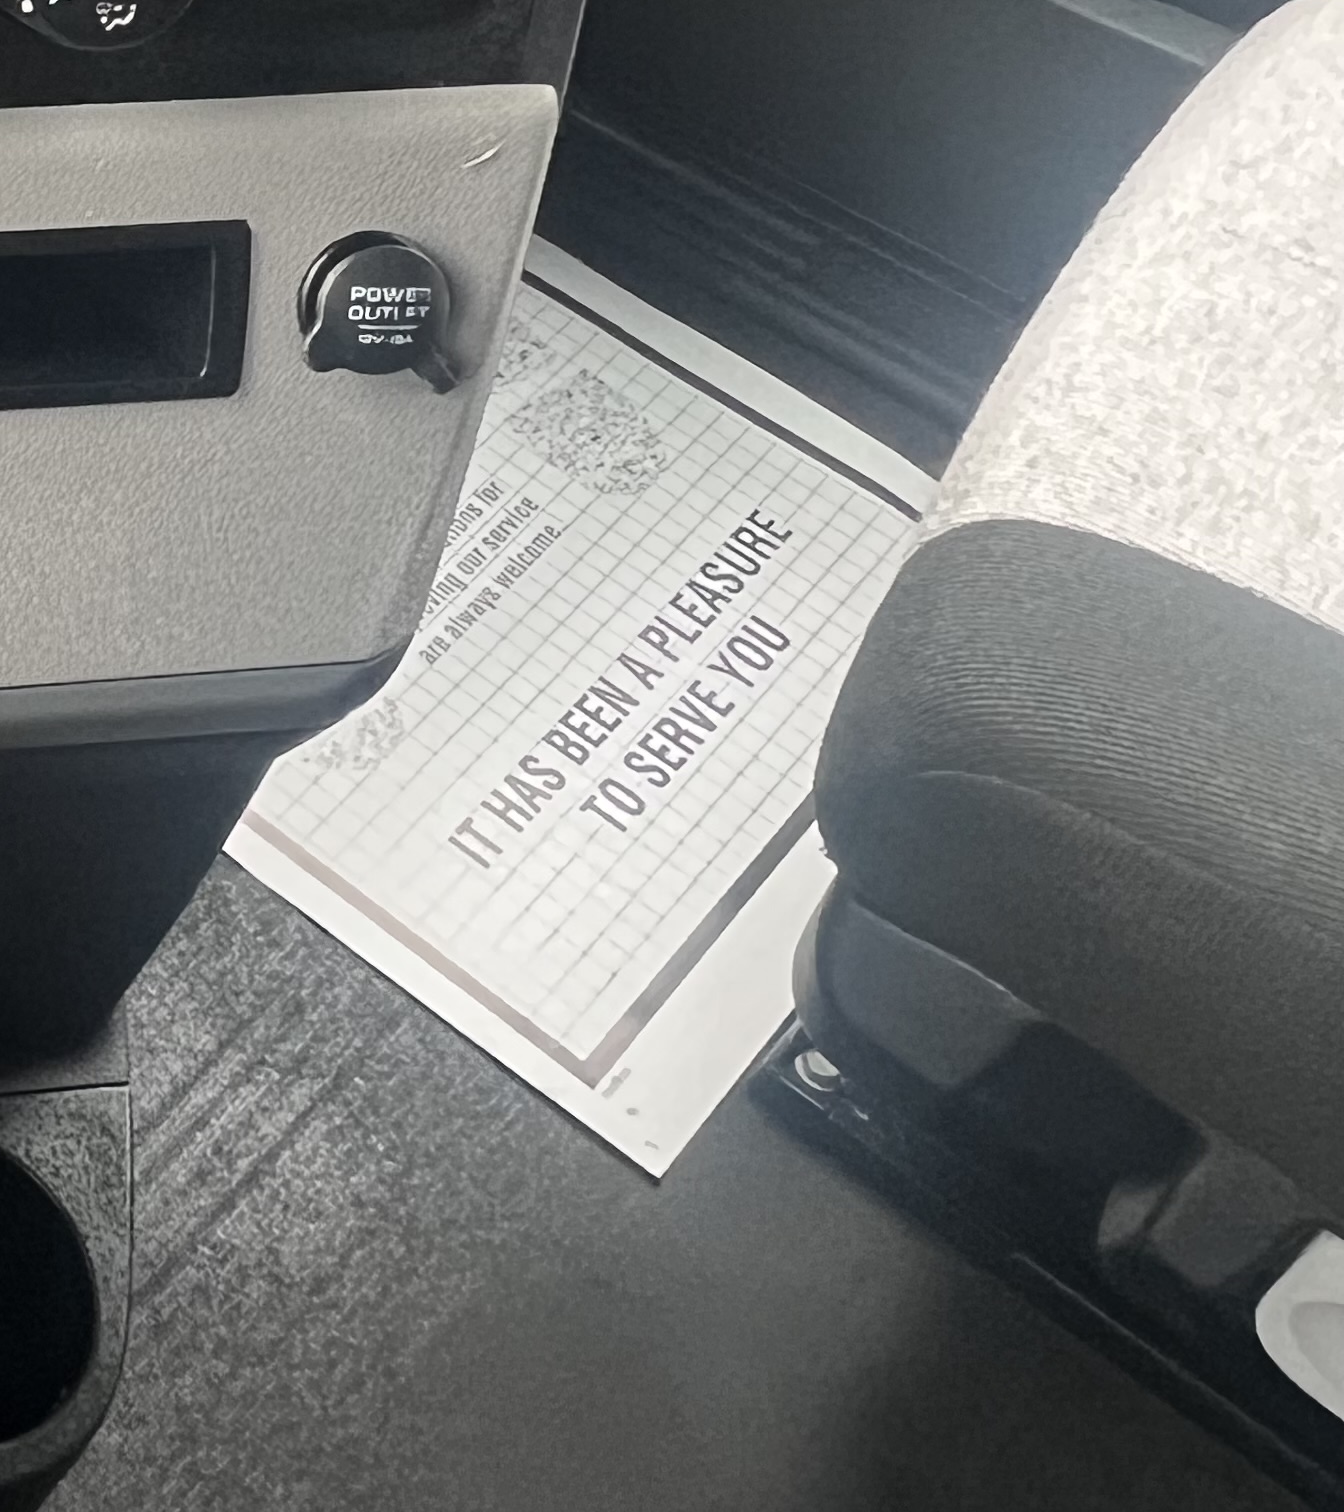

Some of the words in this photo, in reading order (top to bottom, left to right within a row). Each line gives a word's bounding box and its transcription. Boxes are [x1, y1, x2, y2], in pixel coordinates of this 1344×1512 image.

[347, 305, 431, 321] OUTLET
[350, 286, 431, 303] POWER
[475, 481, 504, 507] for
[457, 547, 487, 575] our
[482, 497, 539, 552] service
[419, 635, 451, 665] are
[444, 586, 501, 640] always
[493, 525, 561, 589] welcome
[638, 509, 793, 662] PLEASURE
[616, 653, 665, 690] A
[542, 676, 640, 766] BEEN
[579, 778, 646, 832] TO
[624, 680, 735, 788] SERVE
[707, 615, 791, 687] YOU
[480, 755, 566, 832] HAS
[448, 817, 503, 868] IT
